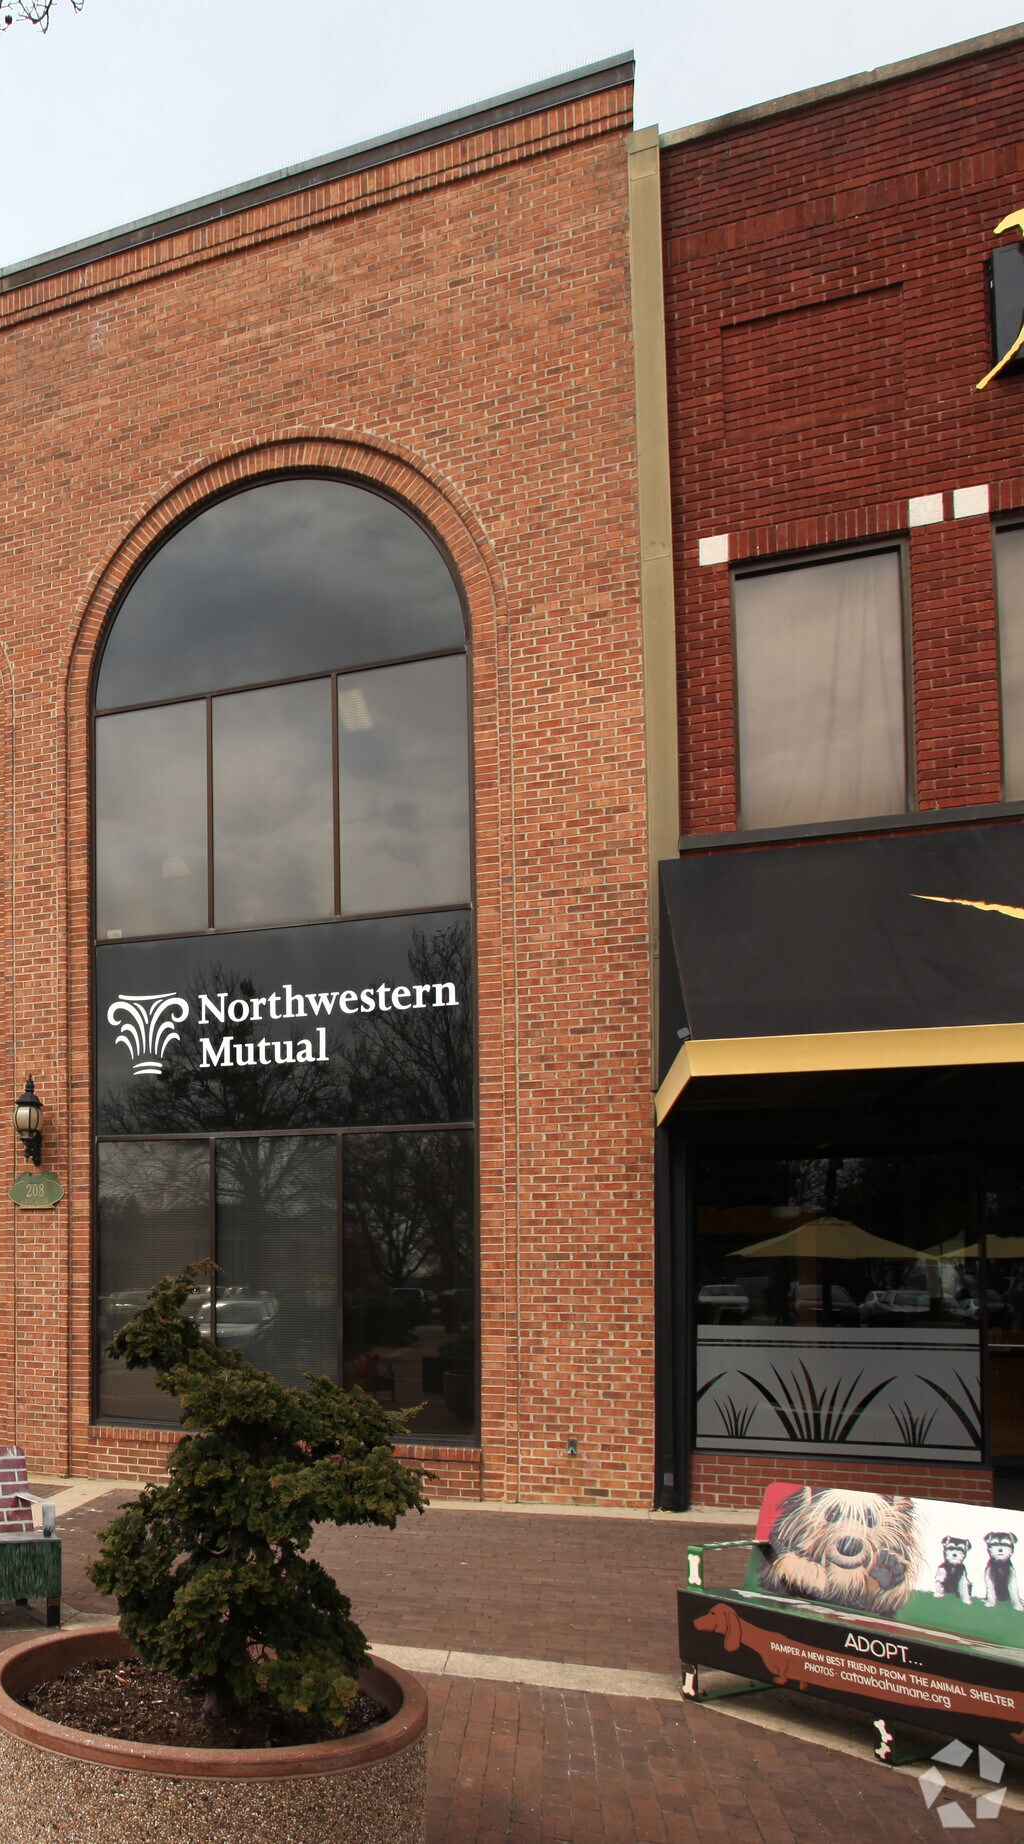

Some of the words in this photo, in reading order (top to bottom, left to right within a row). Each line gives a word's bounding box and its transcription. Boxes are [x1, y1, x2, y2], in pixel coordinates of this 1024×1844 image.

[197, 981, 460, 1025] Northwestern
[199, 1027, 330, 1068] Mutual
[26, 1184, 45, 1198] 208
[770, 1641, 801, 1657] PAMPER
[801, 1649, 807, 1659] A
[807, 1652, 824, 1663] NEW
[826, 1655, 845, 1667] BEST
[847, 1660, 877, 1675] FRIEND
[879, 1667, 907, 1682] FROM
[909, 1674, 929, 1687] THE
[930, 1680, 967, 1696] ANIMAL
[969, 1688, 1016, 1709] SHELTER
[840, 1670, 951, 1708] catawbahumane.org
